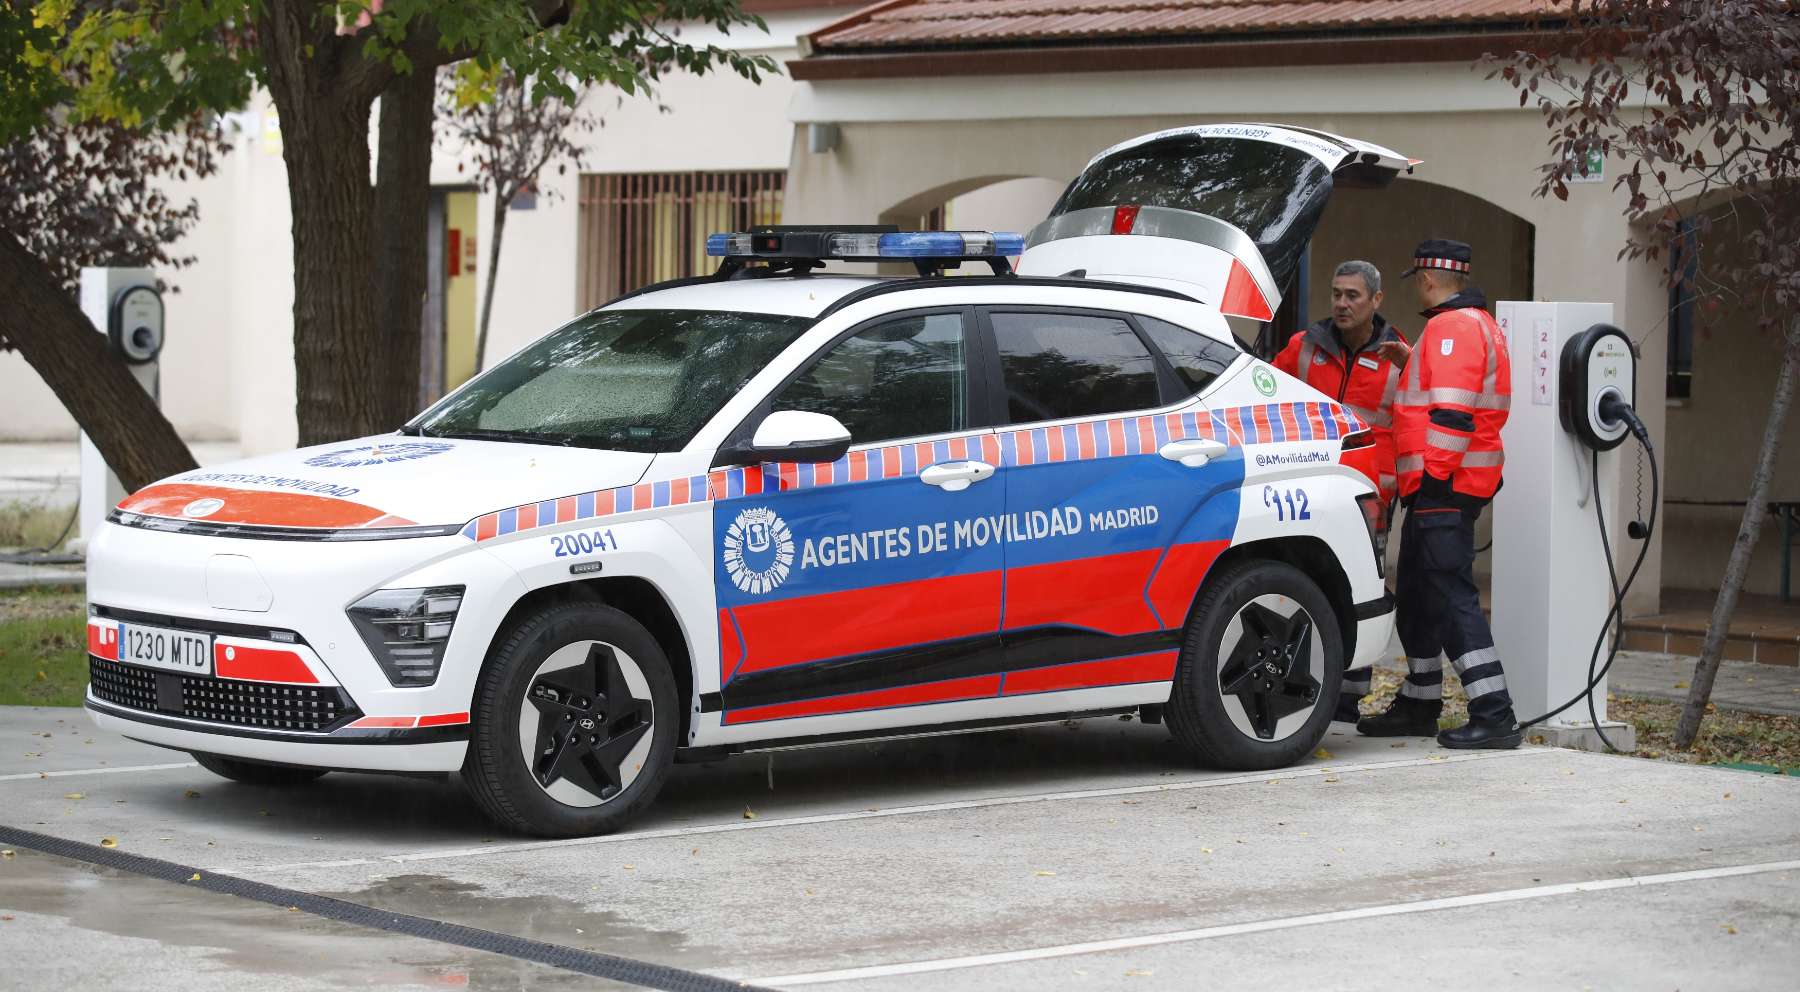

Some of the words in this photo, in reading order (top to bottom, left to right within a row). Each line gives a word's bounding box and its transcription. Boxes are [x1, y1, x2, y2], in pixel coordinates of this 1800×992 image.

[1256, 451, 1330, 466] @AMovilidadMad
[1272, 488, 1311, 521] 112
[550, 529, 618, 557] 20041
[801, 526, 911, 570] AGENTES
[918, 522, 947, 554] DE
[954, 506, 1083, 549] MOVILIDAD
[1089, 505, 1159, 532] MADRID
[128, 629, 165, 662] 1230
[171, 635, 205, 667] MTD
